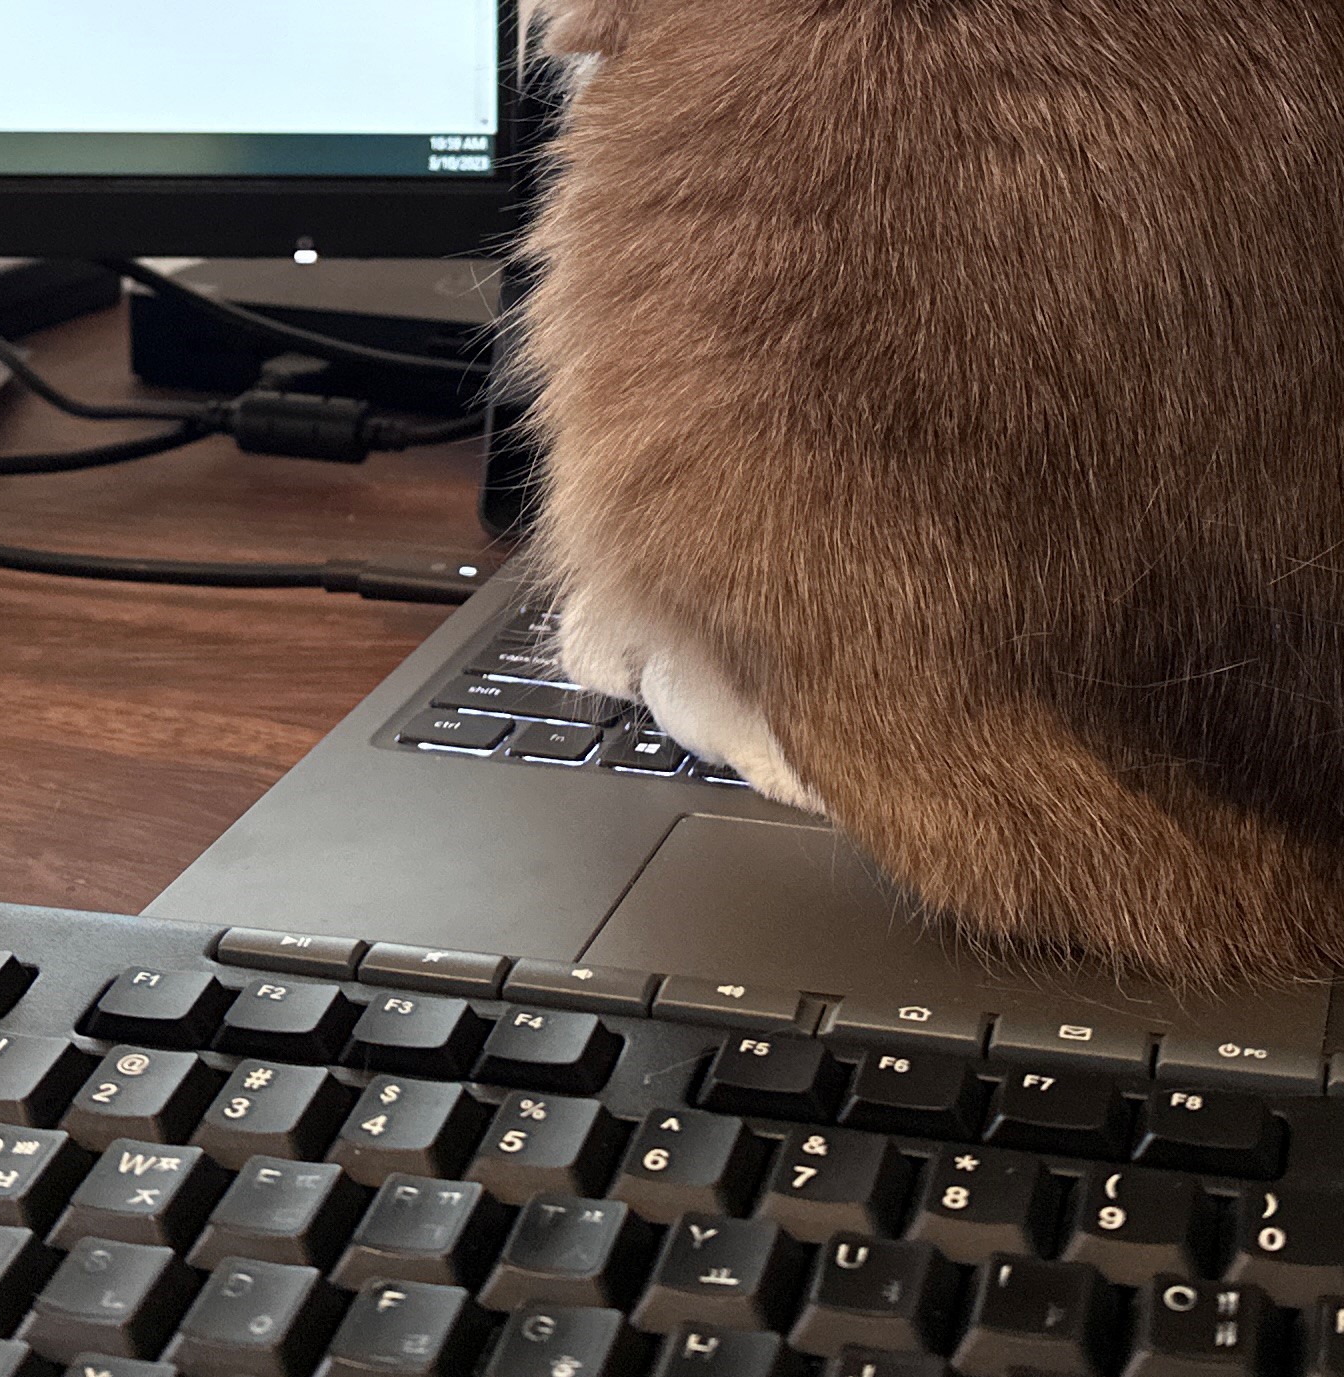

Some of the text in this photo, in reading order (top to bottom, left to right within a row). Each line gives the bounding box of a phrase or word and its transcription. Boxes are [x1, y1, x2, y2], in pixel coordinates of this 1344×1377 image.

[433, 720, 461, 730] ctrl
[133, 971, 161, 986] F1
[257, 984, 287, 1000] F2
[384, 998, 414, 1014] F3
[514, 1013, 543, 1029] F4
[739, 1039, 770, 1056] F5
[878, 1055, 910, 1073] F6
[1022, 1074, 1055, 1091] F7
[1170, 1092, 1202, 1110] F8
